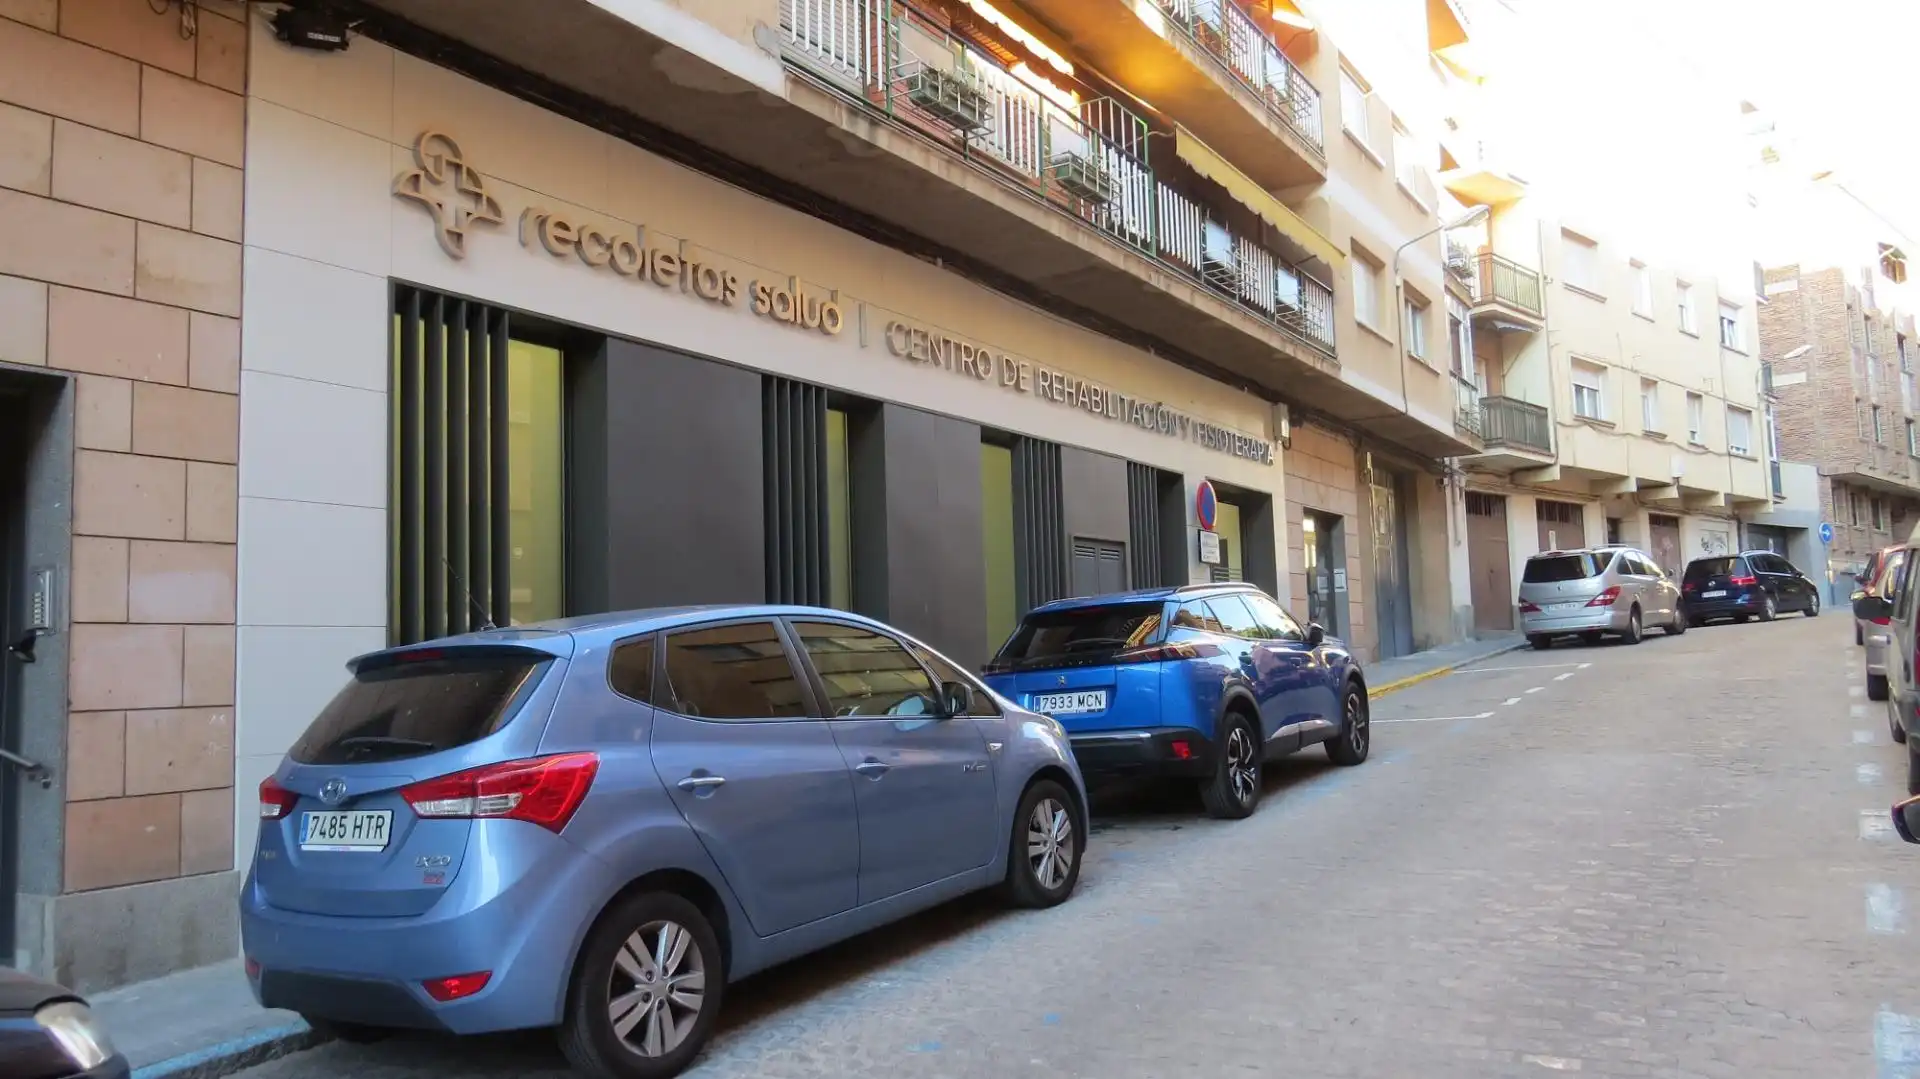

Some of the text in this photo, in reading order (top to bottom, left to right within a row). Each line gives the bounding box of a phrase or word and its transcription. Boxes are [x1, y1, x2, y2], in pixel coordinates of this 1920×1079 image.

[518, 205, 844, 335] recoletas salud
[886, 320, 993, 381] CENTRO
[1000, 355, 1030, 392] DE
[1033, 365, 1177, 436] REHABILITACIÓN
[1179, 414, 1191, 441] Y
[1042, 693, 1102, 710] 7933 MCN
[310, 814, 385, 839] 7485 HTR
